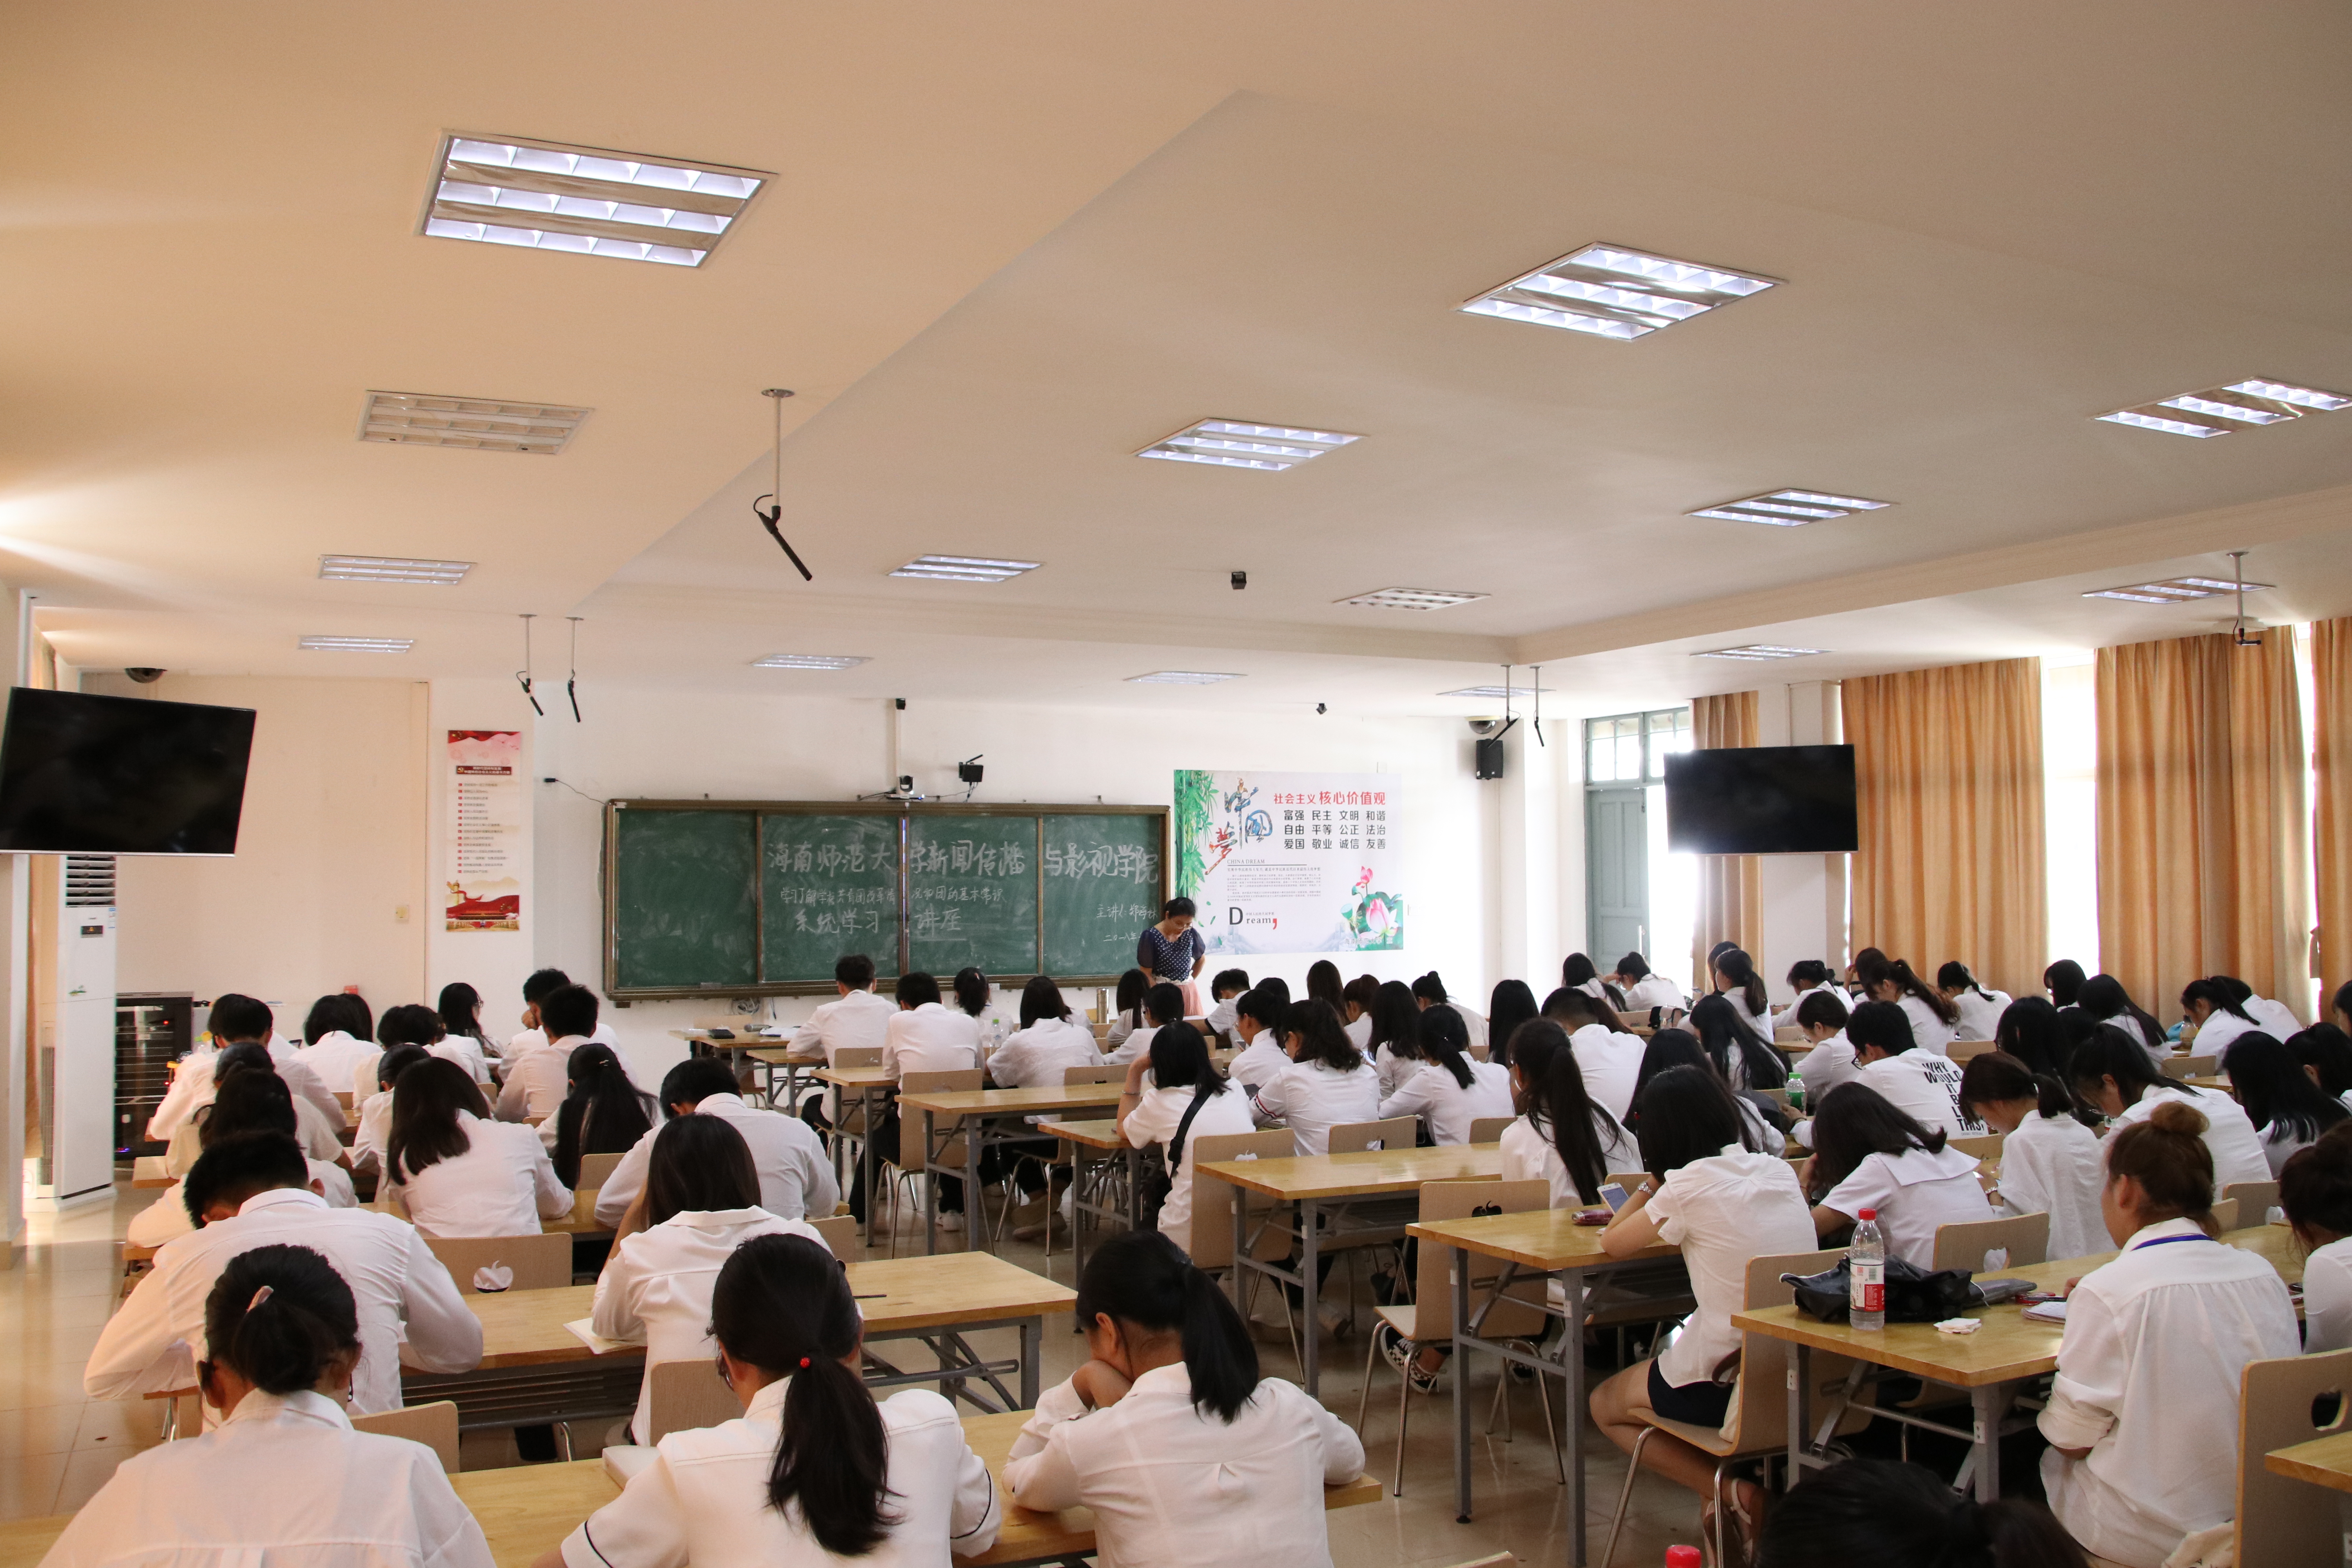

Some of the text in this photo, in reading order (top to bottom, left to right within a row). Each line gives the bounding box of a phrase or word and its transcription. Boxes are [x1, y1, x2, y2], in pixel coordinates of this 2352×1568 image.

[1284, 810, 1386, 821] 富强 民主 文明 和谐
[1284, 824, 1386, 835] 自由 平等 公正 法治
[1284, 838, 1386, 849] 爱国 敬业 诚信 友善
[1922, 1062, 1949, 1073] WHY
[1924, 1071, 1962, 1083] WOULD
[1945, 1083, 1957, 1094] IT
